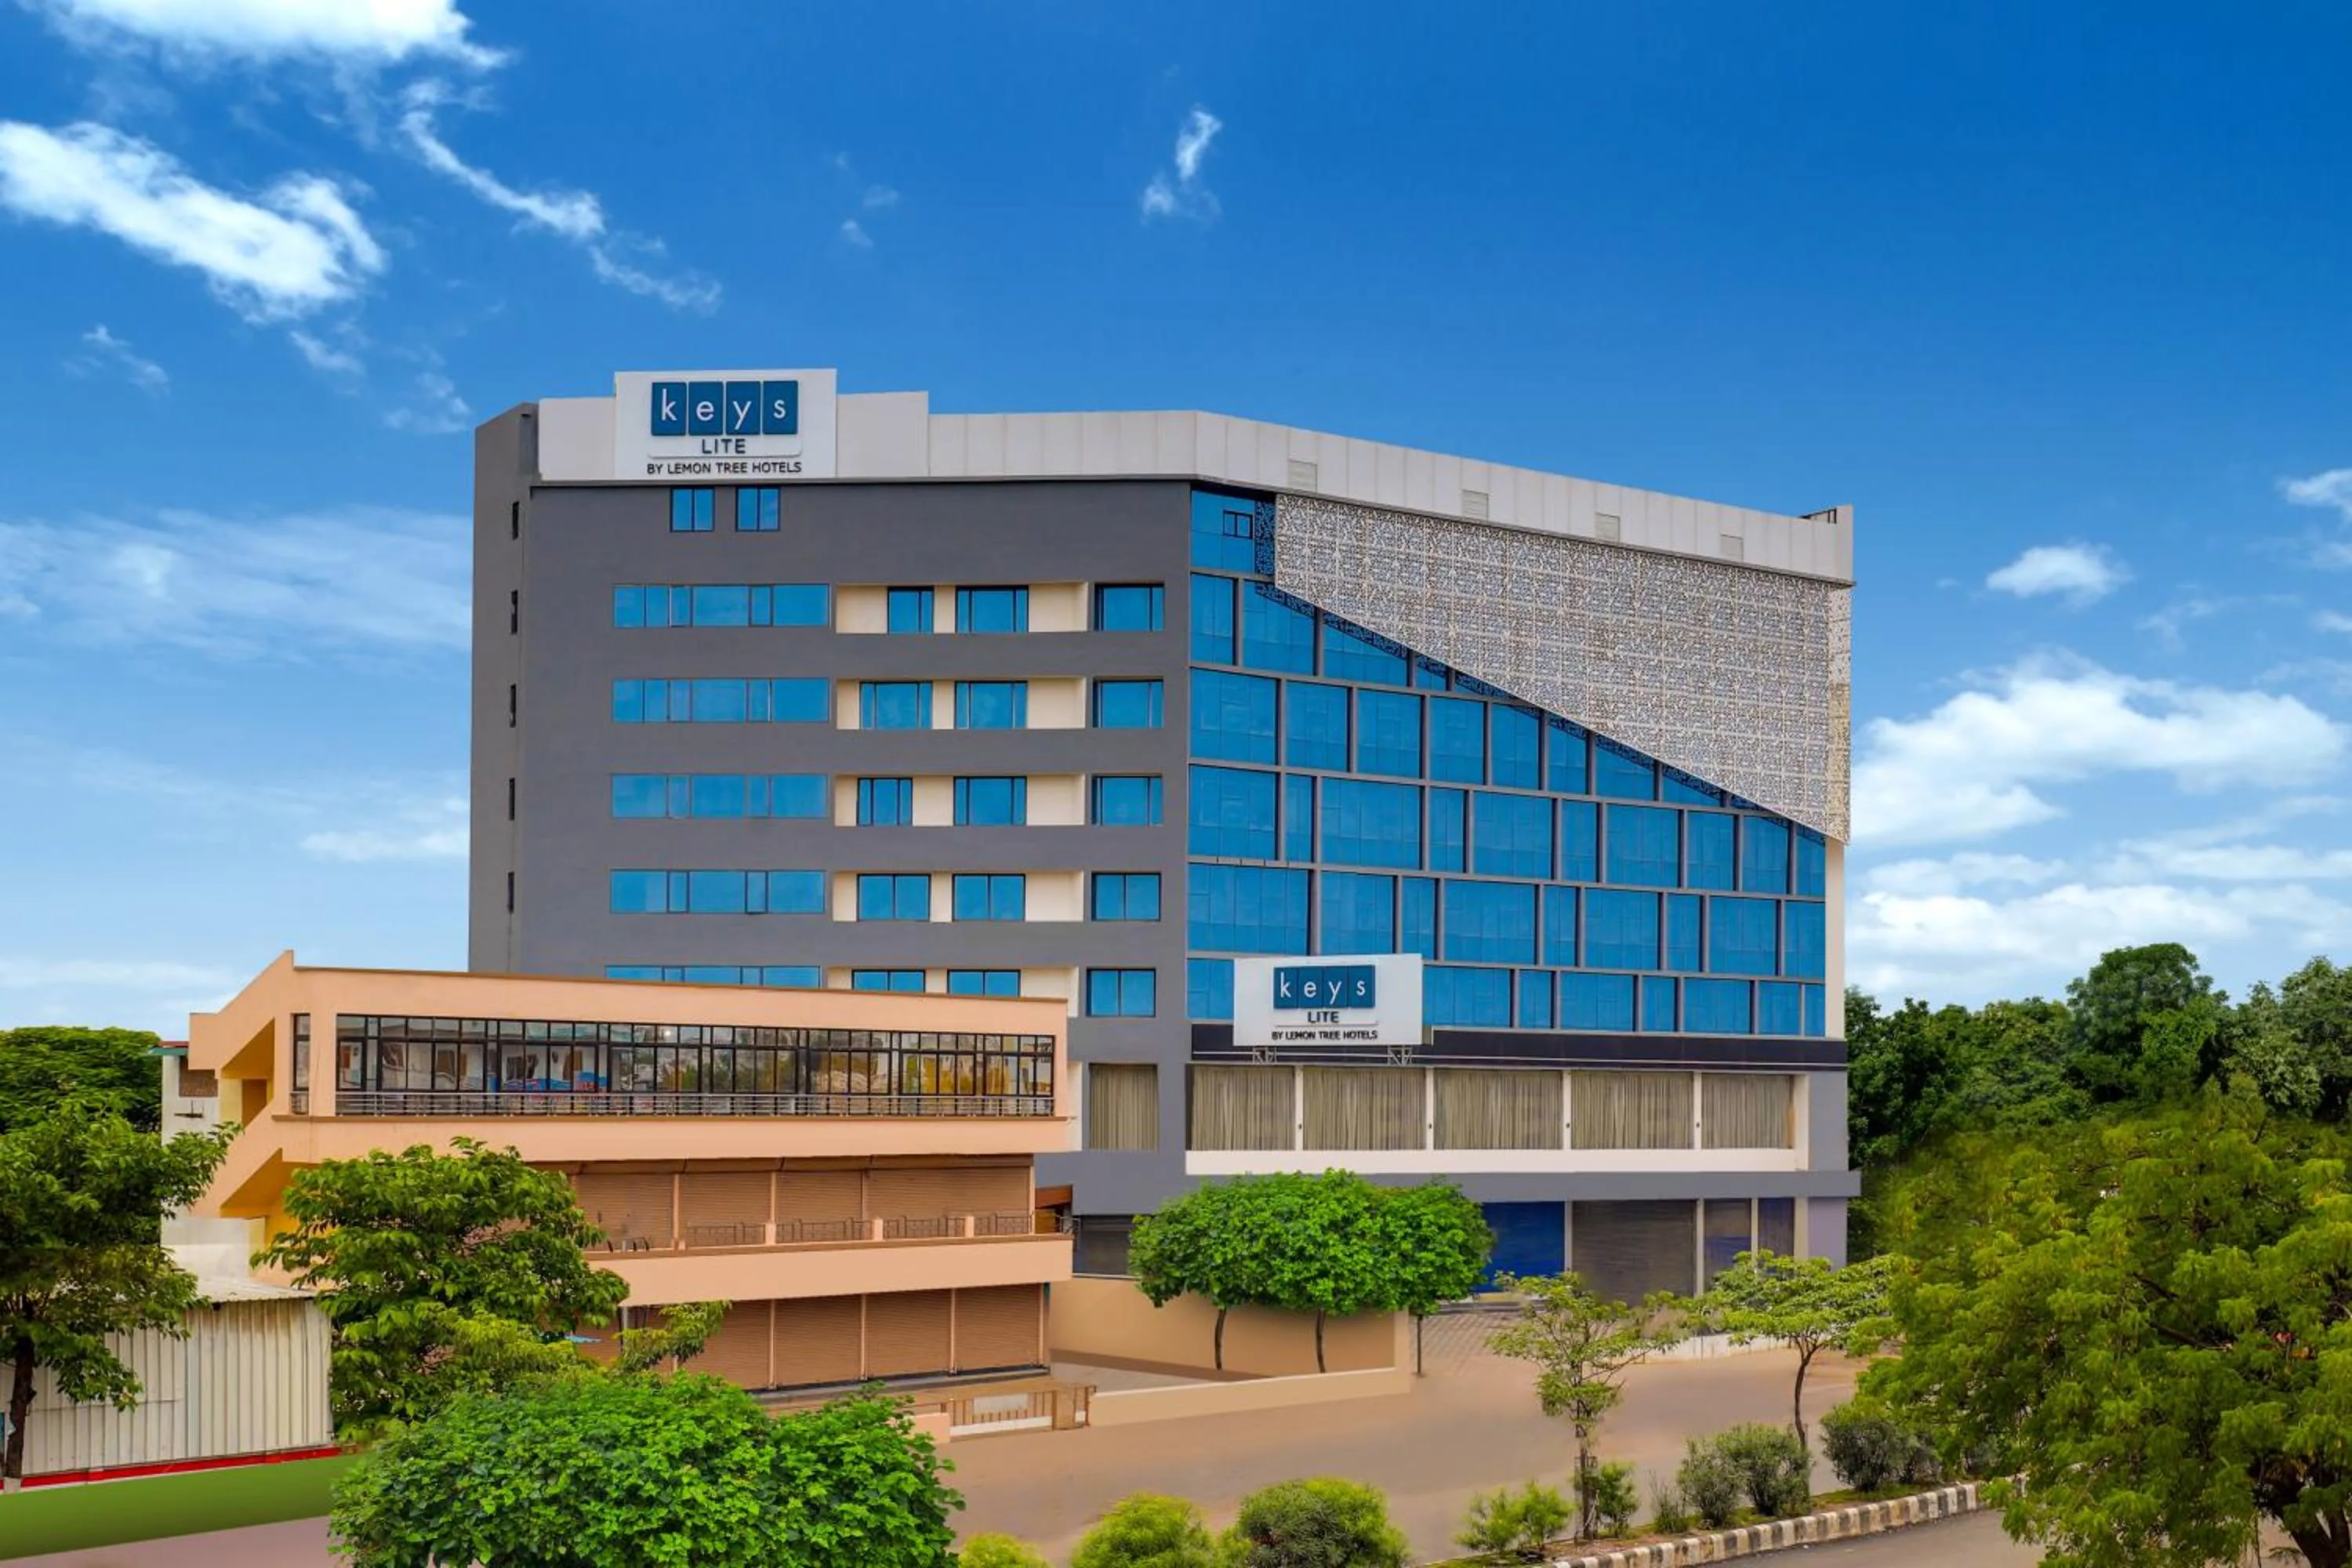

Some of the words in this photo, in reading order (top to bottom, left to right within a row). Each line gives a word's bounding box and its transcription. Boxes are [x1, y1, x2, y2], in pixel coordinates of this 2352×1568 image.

[661, 388, 786, 430] keys
[702, 438, 746, 454] LITE
[647, 463, 662, 474] BY
[667, 463, 711, 474] LEMON
[716, 462, 748, 474] TREE
[752, 462, 801, 473] HOTELS
[1279, 971, 1366, 1004] keys
[1308, 1011, 1339, 1023] LITE
[1272, 1031, 1283, 1040] BY
[1285, 1031, 1316, 1040] LEMON
[1319, 1031, 1341, 1040] TREE
[1343, 1030, 1377, 1040] HOTELS
